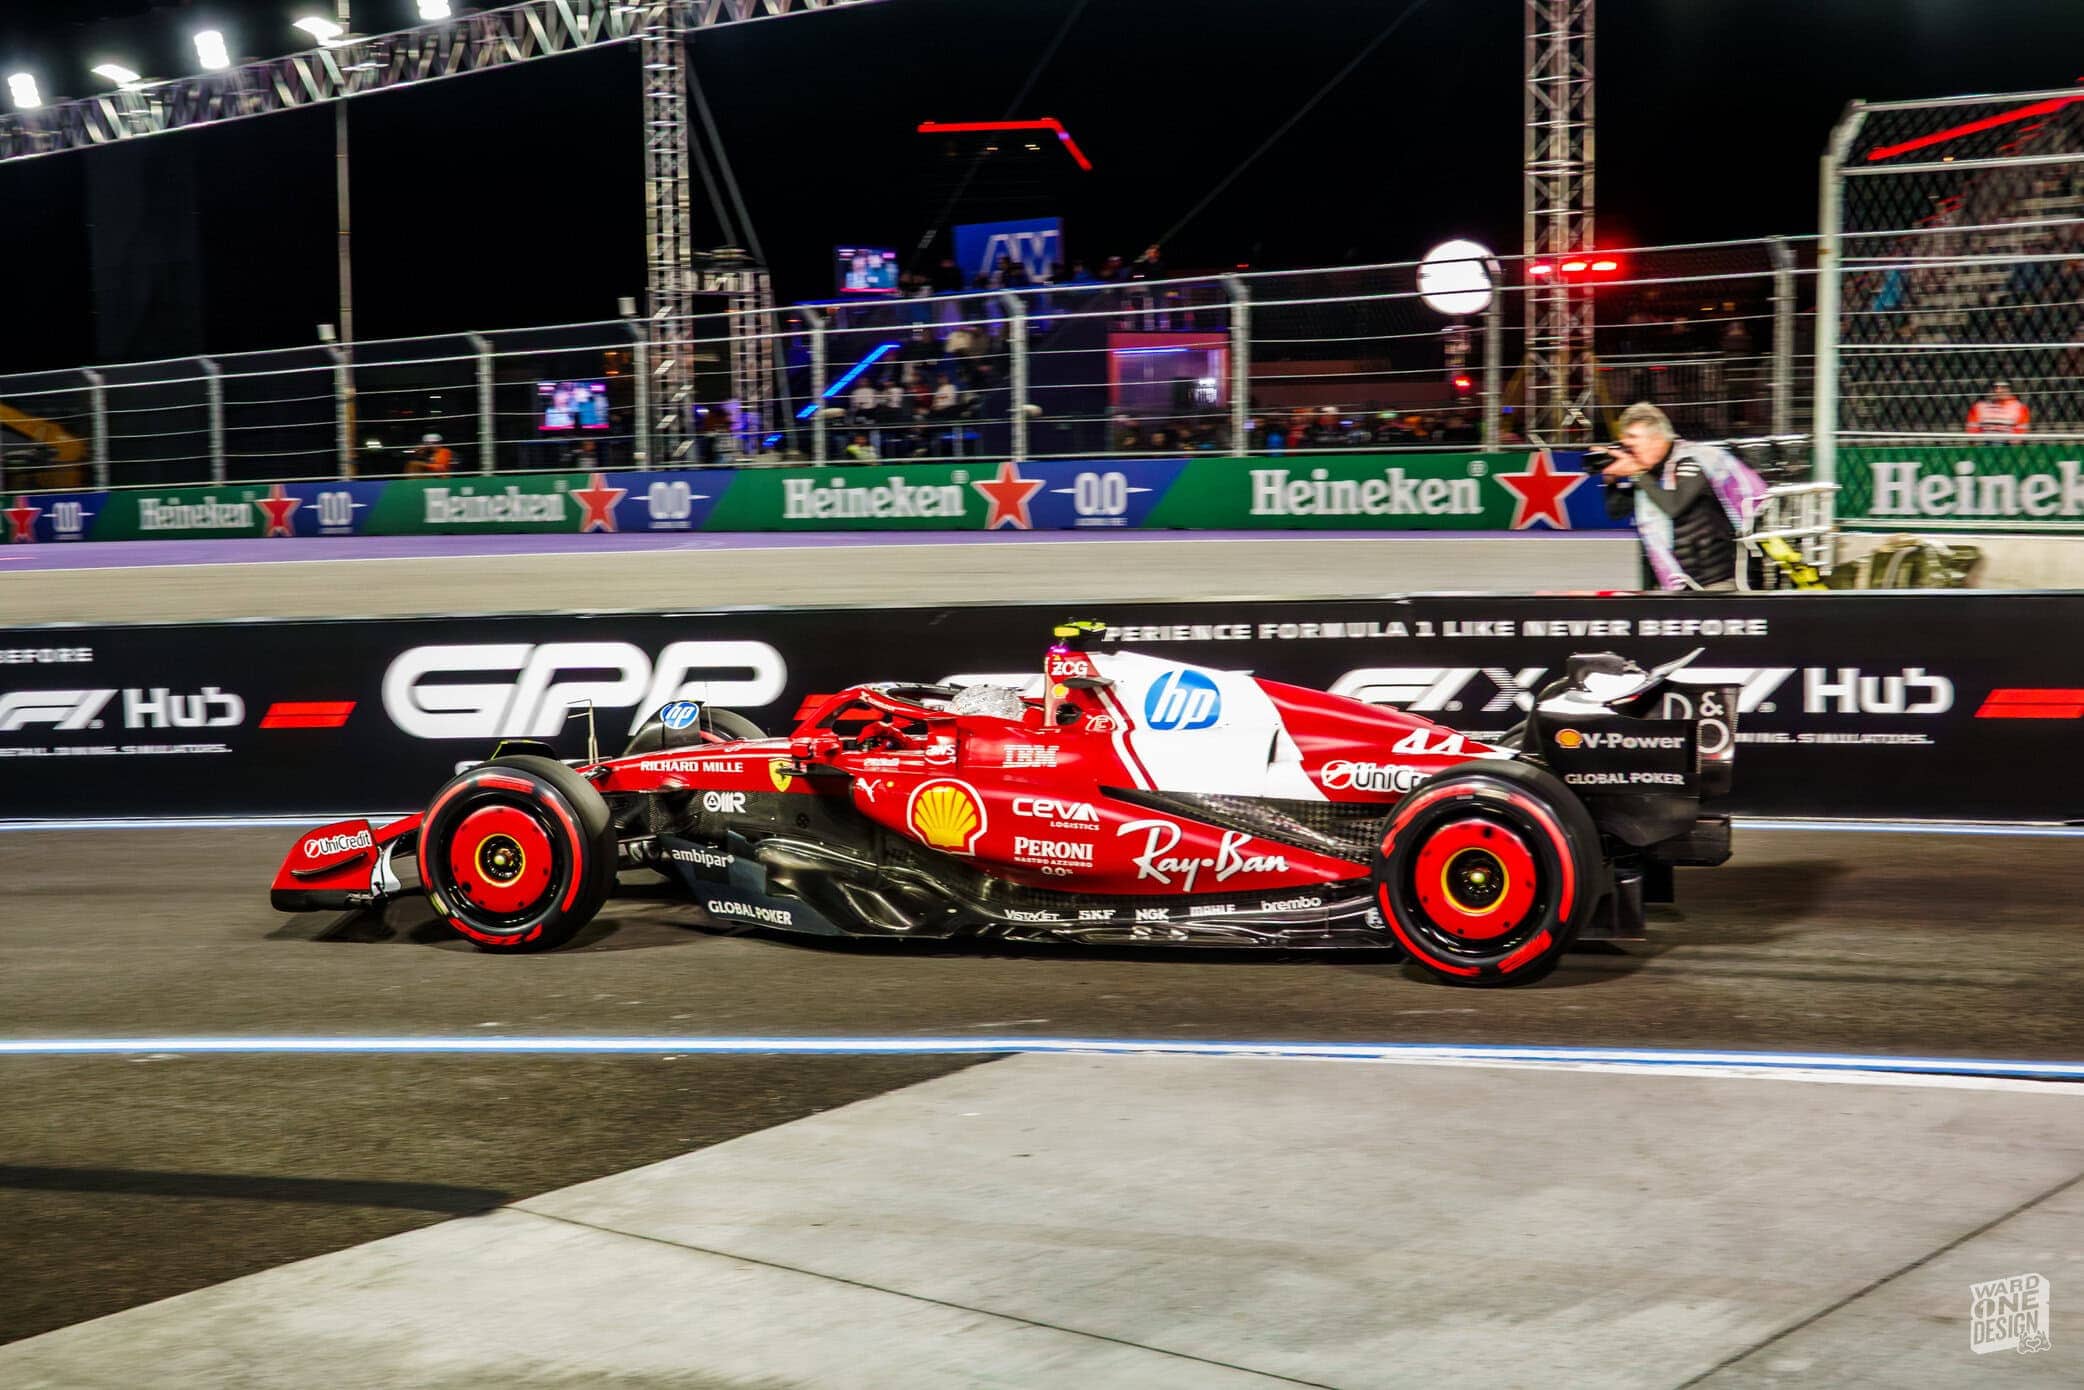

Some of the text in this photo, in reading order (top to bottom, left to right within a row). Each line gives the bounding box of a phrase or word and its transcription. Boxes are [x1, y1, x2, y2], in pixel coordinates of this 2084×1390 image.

[782, 476, 966, 519] Heineken
[1249, 468, 1485, 516] Heineken
[1868, 461, 2084, 516] Heinek
[424, 486, 566, 523] Heineken
[1101, 618, 1767, 642] PERIENCE FORMULA 1 LIKE NEVER BEFORE
[1051, 661, 1088, 676] ZCG
[1149, 669, 1220, 730] hp
[1802, 667, 1954, 714] Hub
[123, 687, 246, 729] Hub
[664, 702, 698, 728] hp
[925, 744, 956, 756] aws
[1391, 728, 1465, 755] 44
[1583, 733, 1685, 748] V-Power
[640, 760, 744, 773] RICHARD MILLE
[1002, 744, 1060, 767] IBM
[1354, 763, 1432, 791] UniCr
[1565, 772, 1686, 785] GLOBAL POKER
[1051, 821, 1100, 831] LOGISTICS
[319, 832, 371, 853] UniCredit
[1014, 837, 1094, 861] PERONI
[672, 848, 729, 868] ambipar
[708, 900, 793, 925] GLOBAL POKER
[1078, 910, 1117, 921] SKF
[1135, 908, 1170, 921] NGK
[1260, 896, 1322, 912] brembo
